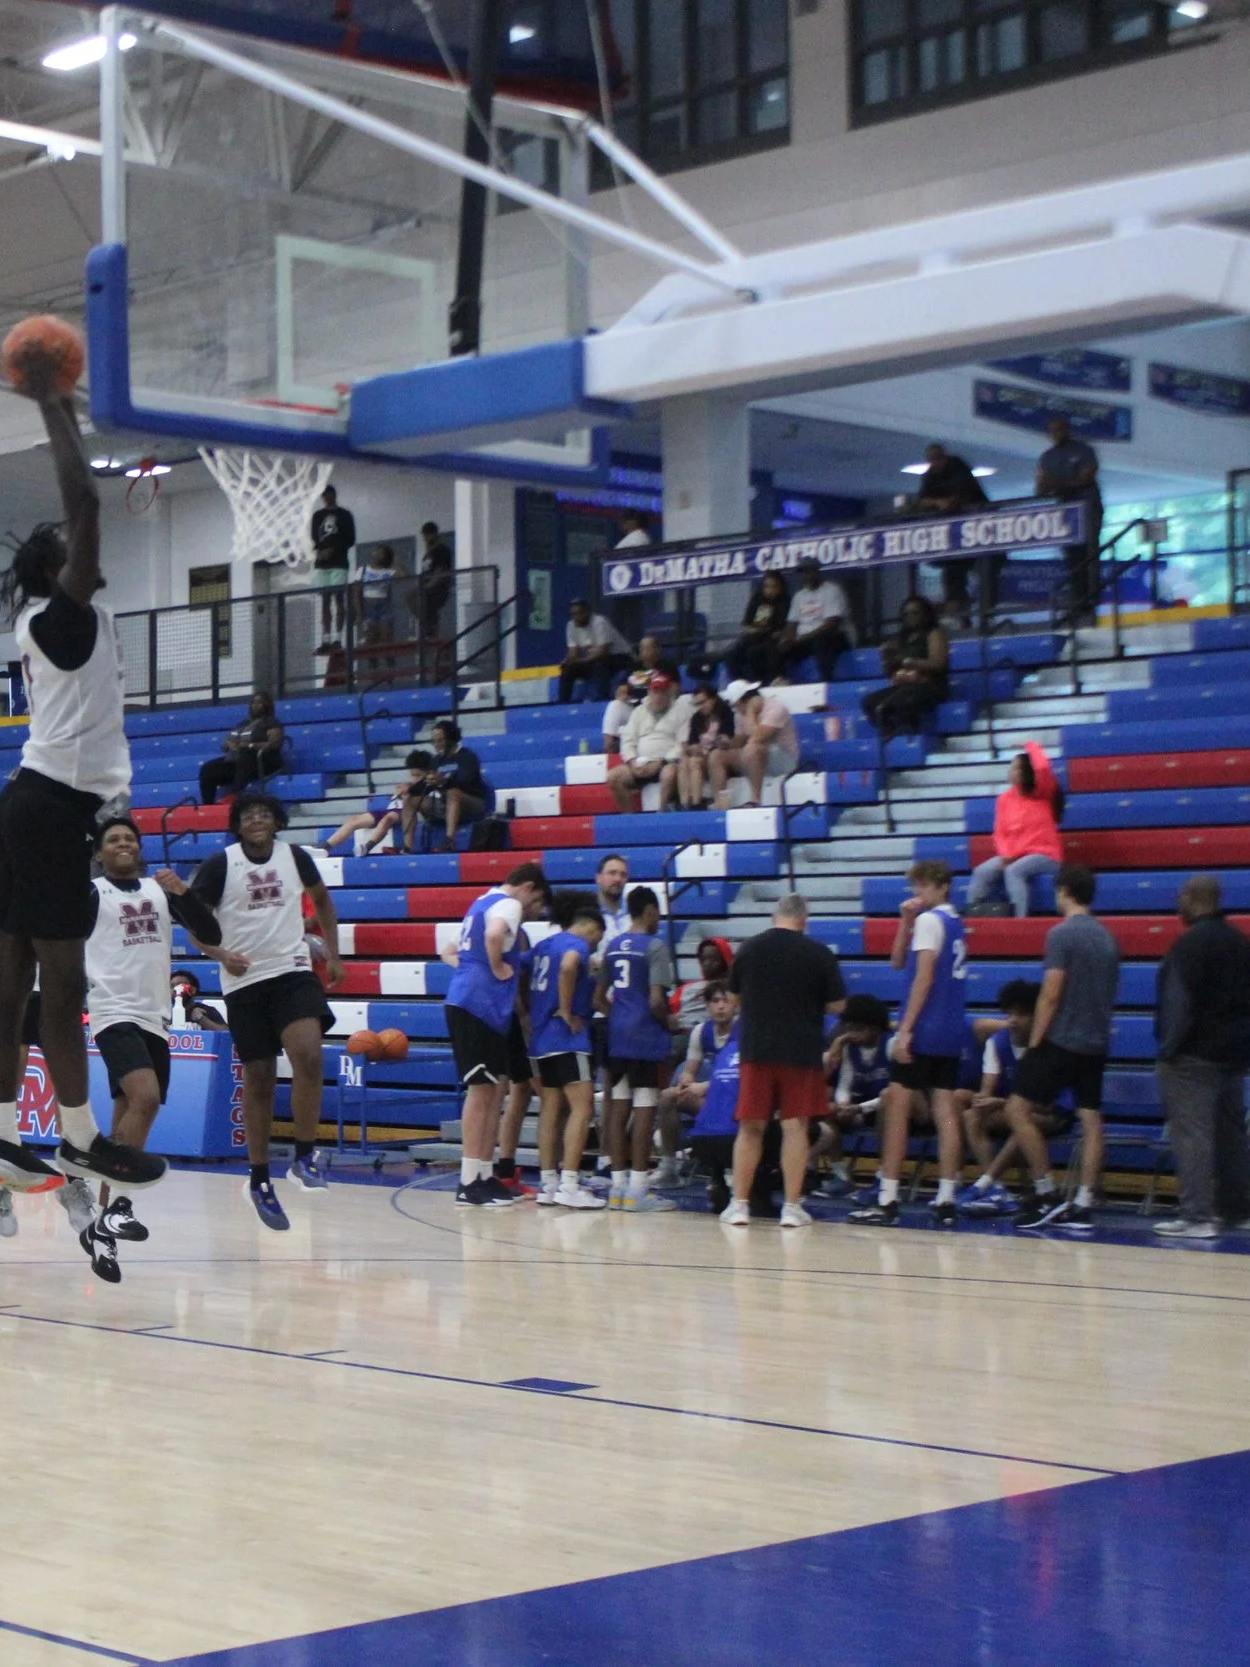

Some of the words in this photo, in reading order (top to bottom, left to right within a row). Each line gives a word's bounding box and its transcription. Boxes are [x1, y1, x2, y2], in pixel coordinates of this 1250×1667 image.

[754, 532, 876, 572] CATHOLIC
[883, 523, 950, 557] HIGH
[960, 511, 1071, 547] SCHOOL
[613, 959, 630, 989] 3
